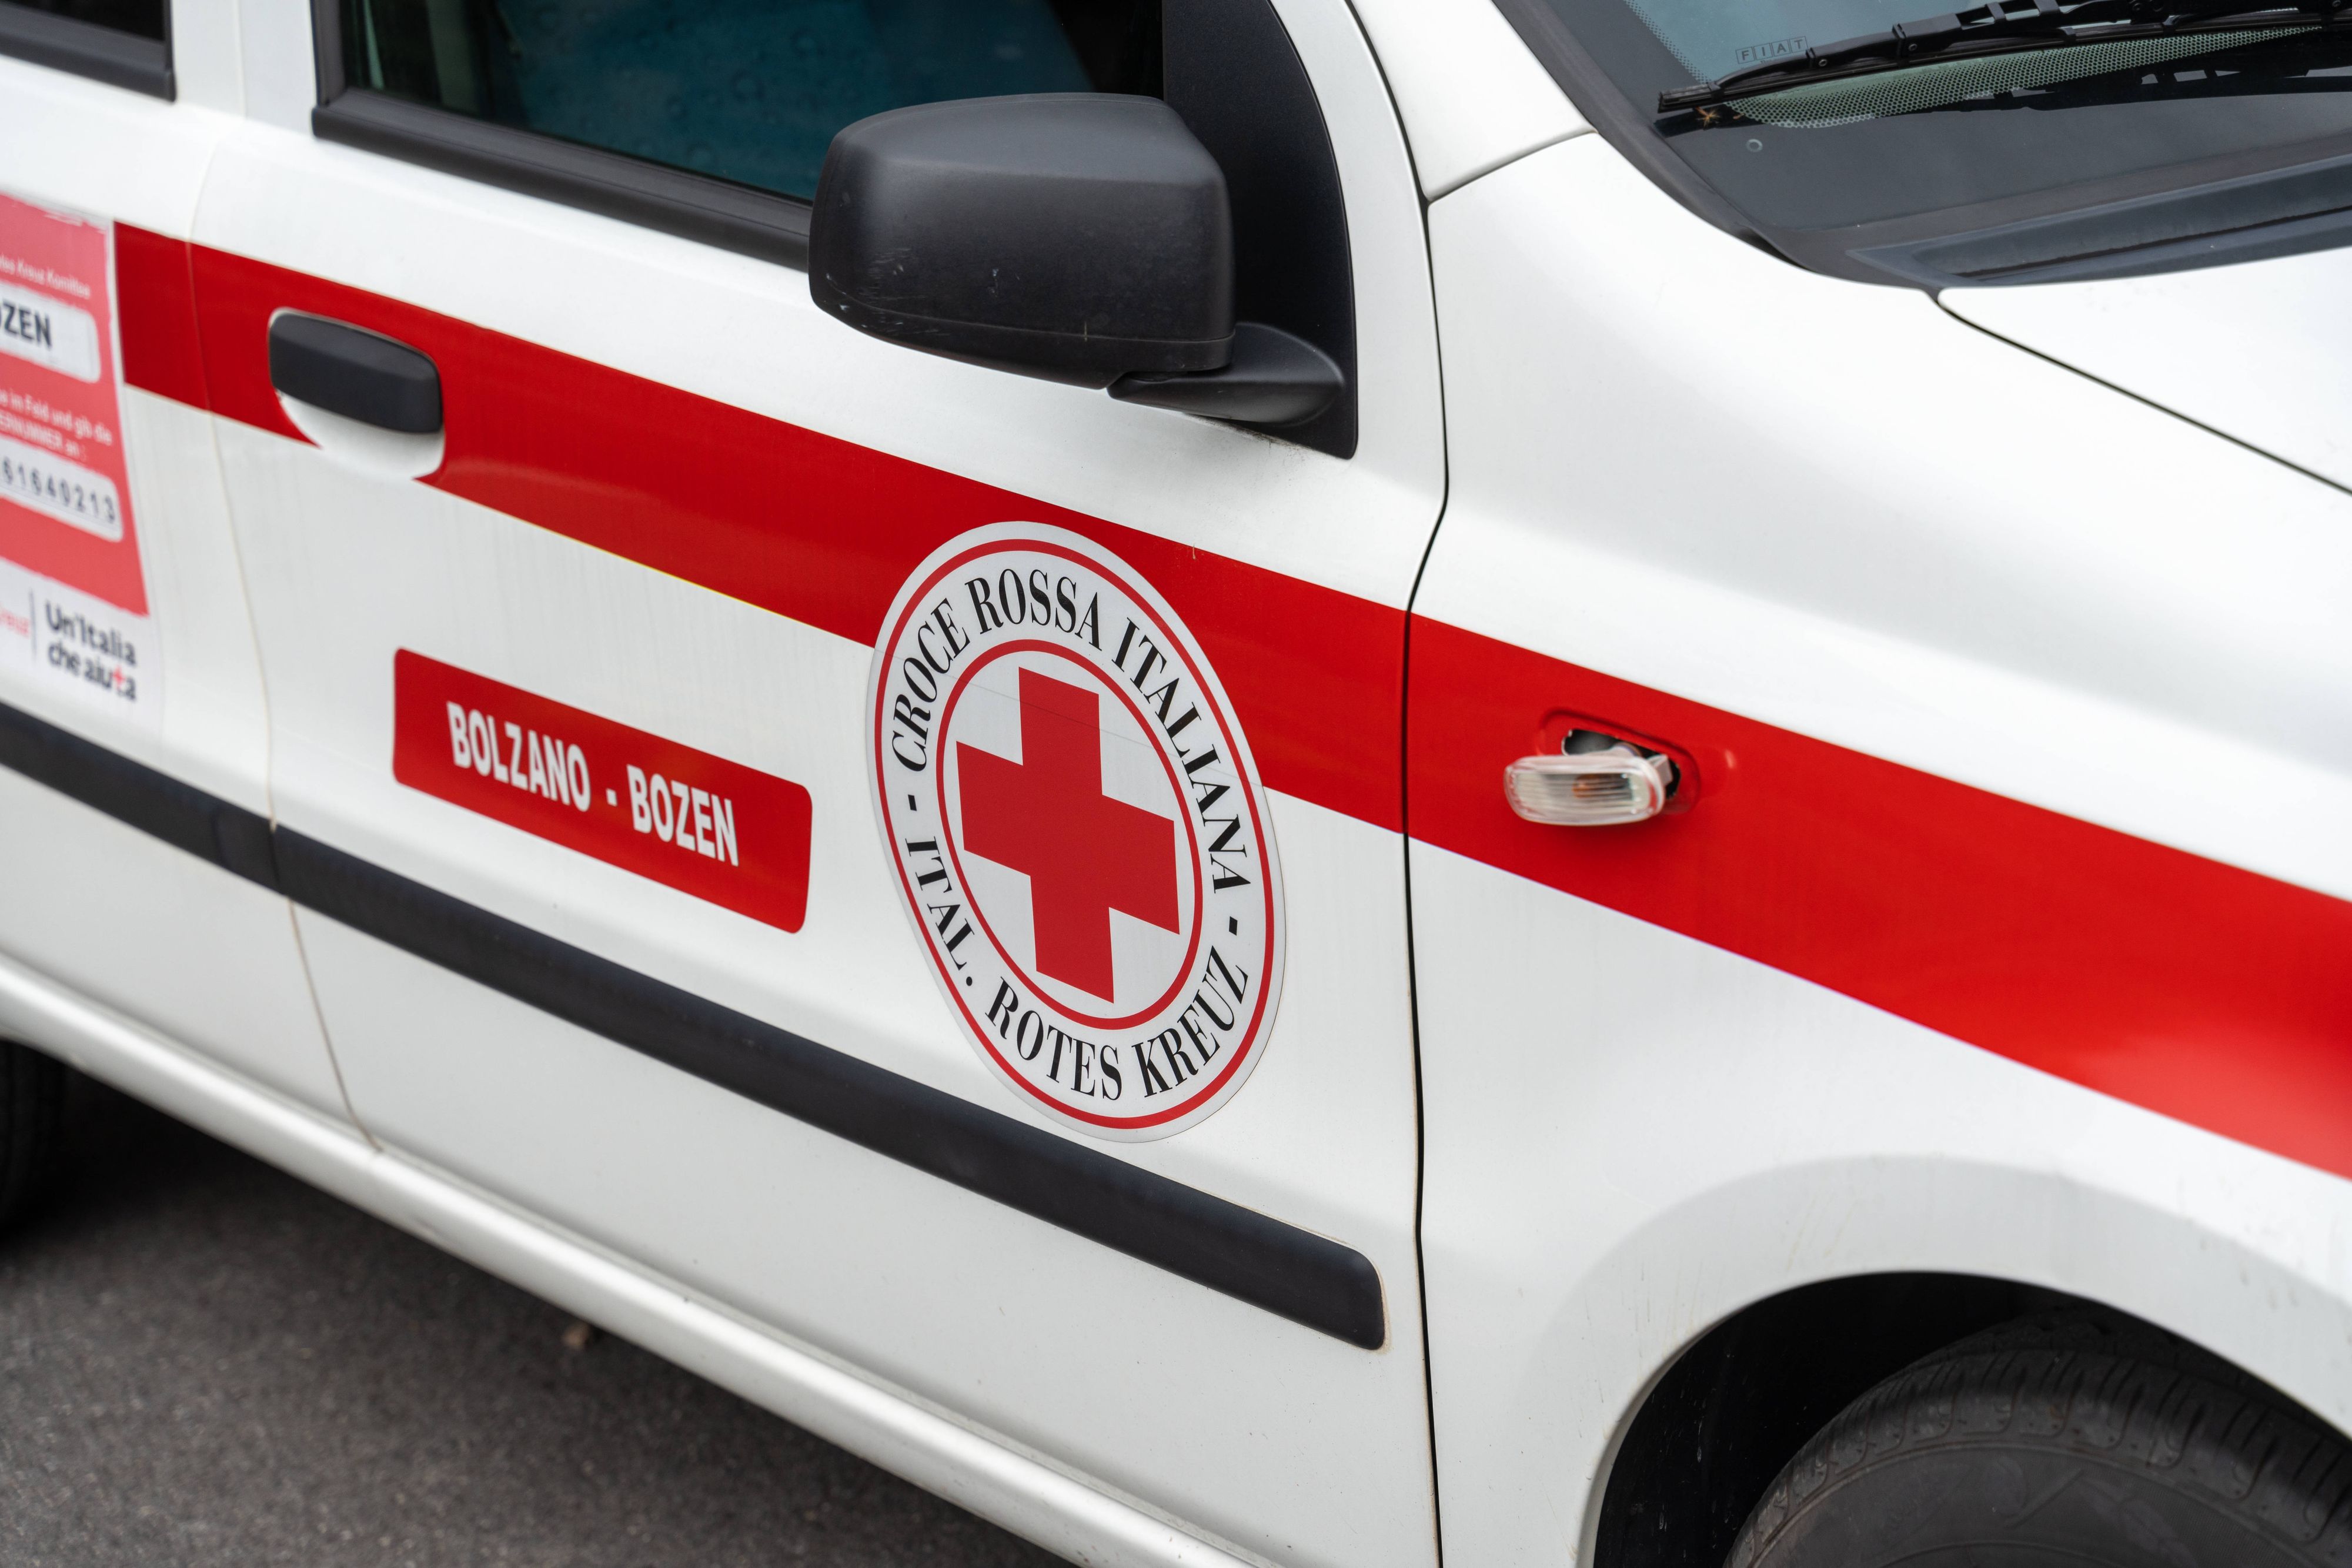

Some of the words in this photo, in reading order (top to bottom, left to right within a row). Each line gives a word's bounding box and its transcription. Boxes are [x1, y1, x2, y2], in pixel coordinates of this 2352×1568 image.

[1741, 39, 1803, 61] FIAT
[0, 300, 52, 347] ZEN
[48, 641, 80, 676] che
[446, 701, 592, 813] BOLZANO
[626, 764, 740, 867] BOZEN
[891, 597, 970, 773] CROCE
[964, 568, 1103, 652] ROSSA
[1111, 616, 1252, 894] ITALIANA
[905, 835, 975, 987] ITAL.
[984, 975, 1123, 1101] ROTES
[1131, 945, 1249, 1098] KREUZ
